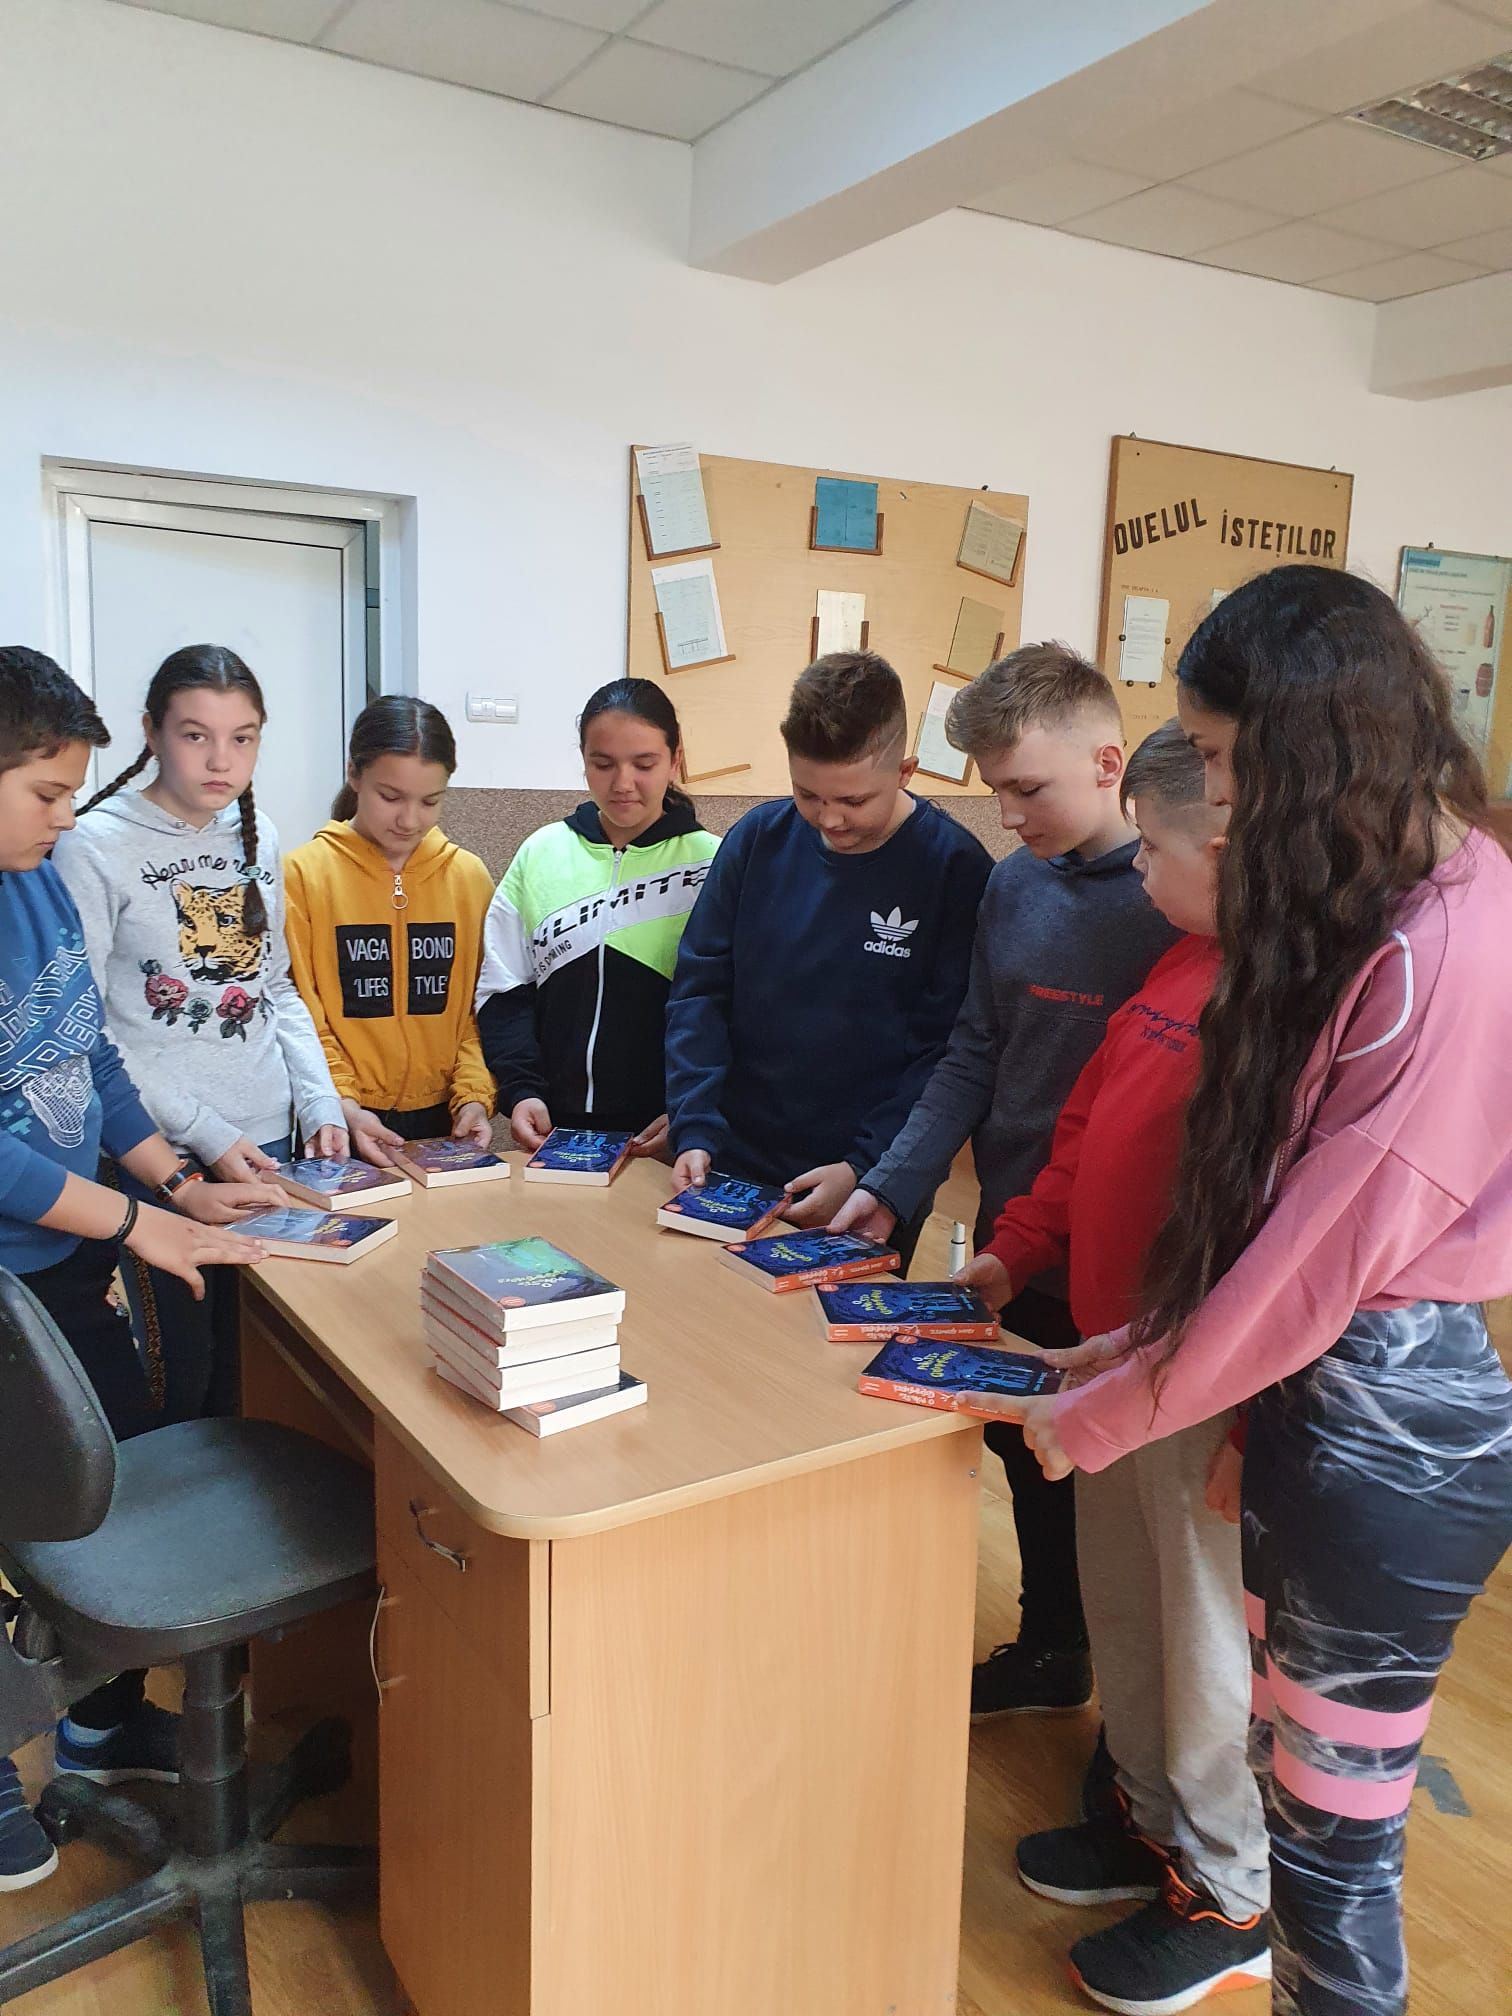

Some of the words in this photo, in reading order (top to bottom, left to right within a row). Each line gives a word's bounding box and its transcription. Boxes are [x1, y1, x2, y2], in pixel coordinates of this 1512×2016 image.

[1114, 498, 1207, 555] DUELUL
[140, 860, 195, 891] Hear
[199, 854, 227, 871] me
[346, 938, 390, 961] VAGA
[411, 936, 454, 960] BOND
[864, 940, 911, 958] adidas
